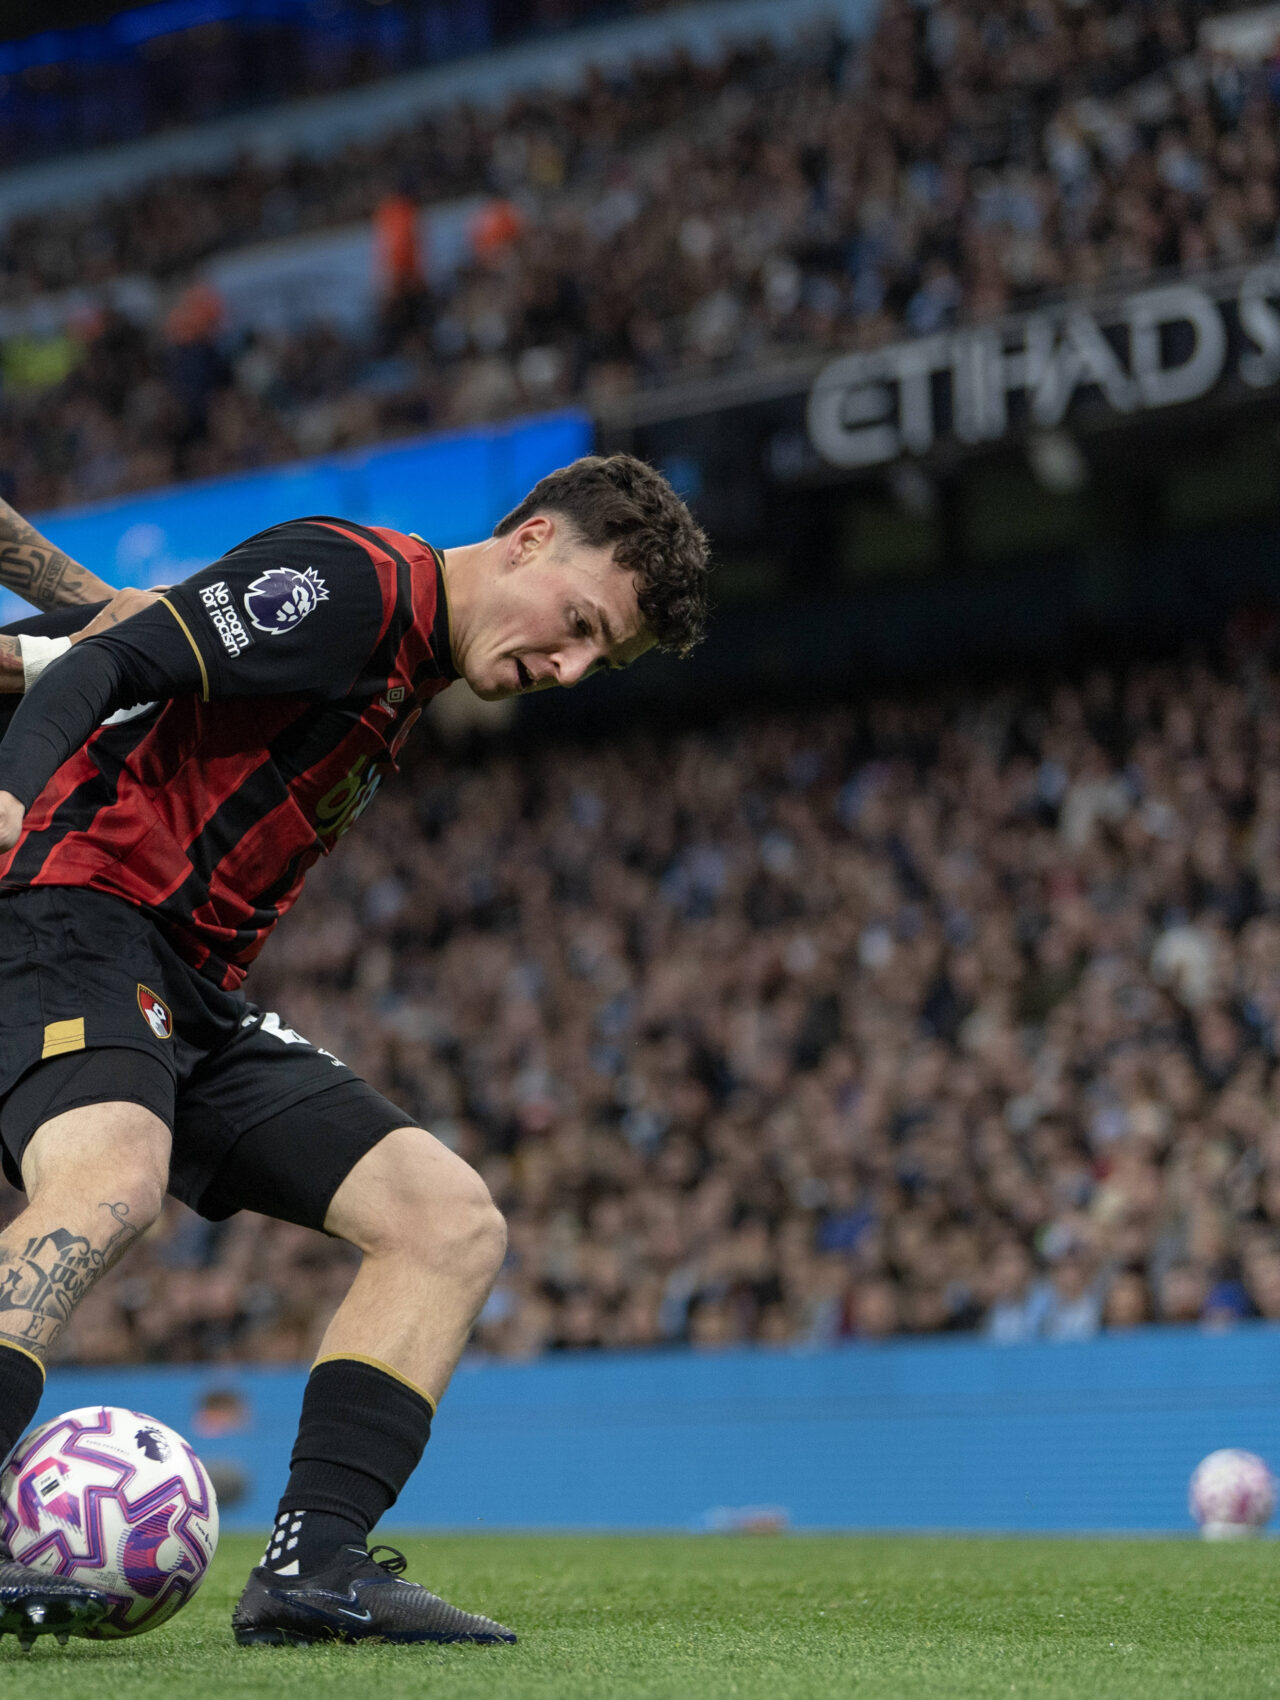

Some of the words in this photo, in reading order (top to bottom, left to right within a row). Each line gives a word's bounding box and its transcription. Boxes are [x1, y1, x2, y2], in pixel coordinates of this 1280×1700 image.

[807, 284, 1227, 469] ETIHAD
[199, 586, 218, 611] for
[209, 609, 241, 659] racism
[211, 581, 229, 605] No
[222, 605, 250, 648] room
